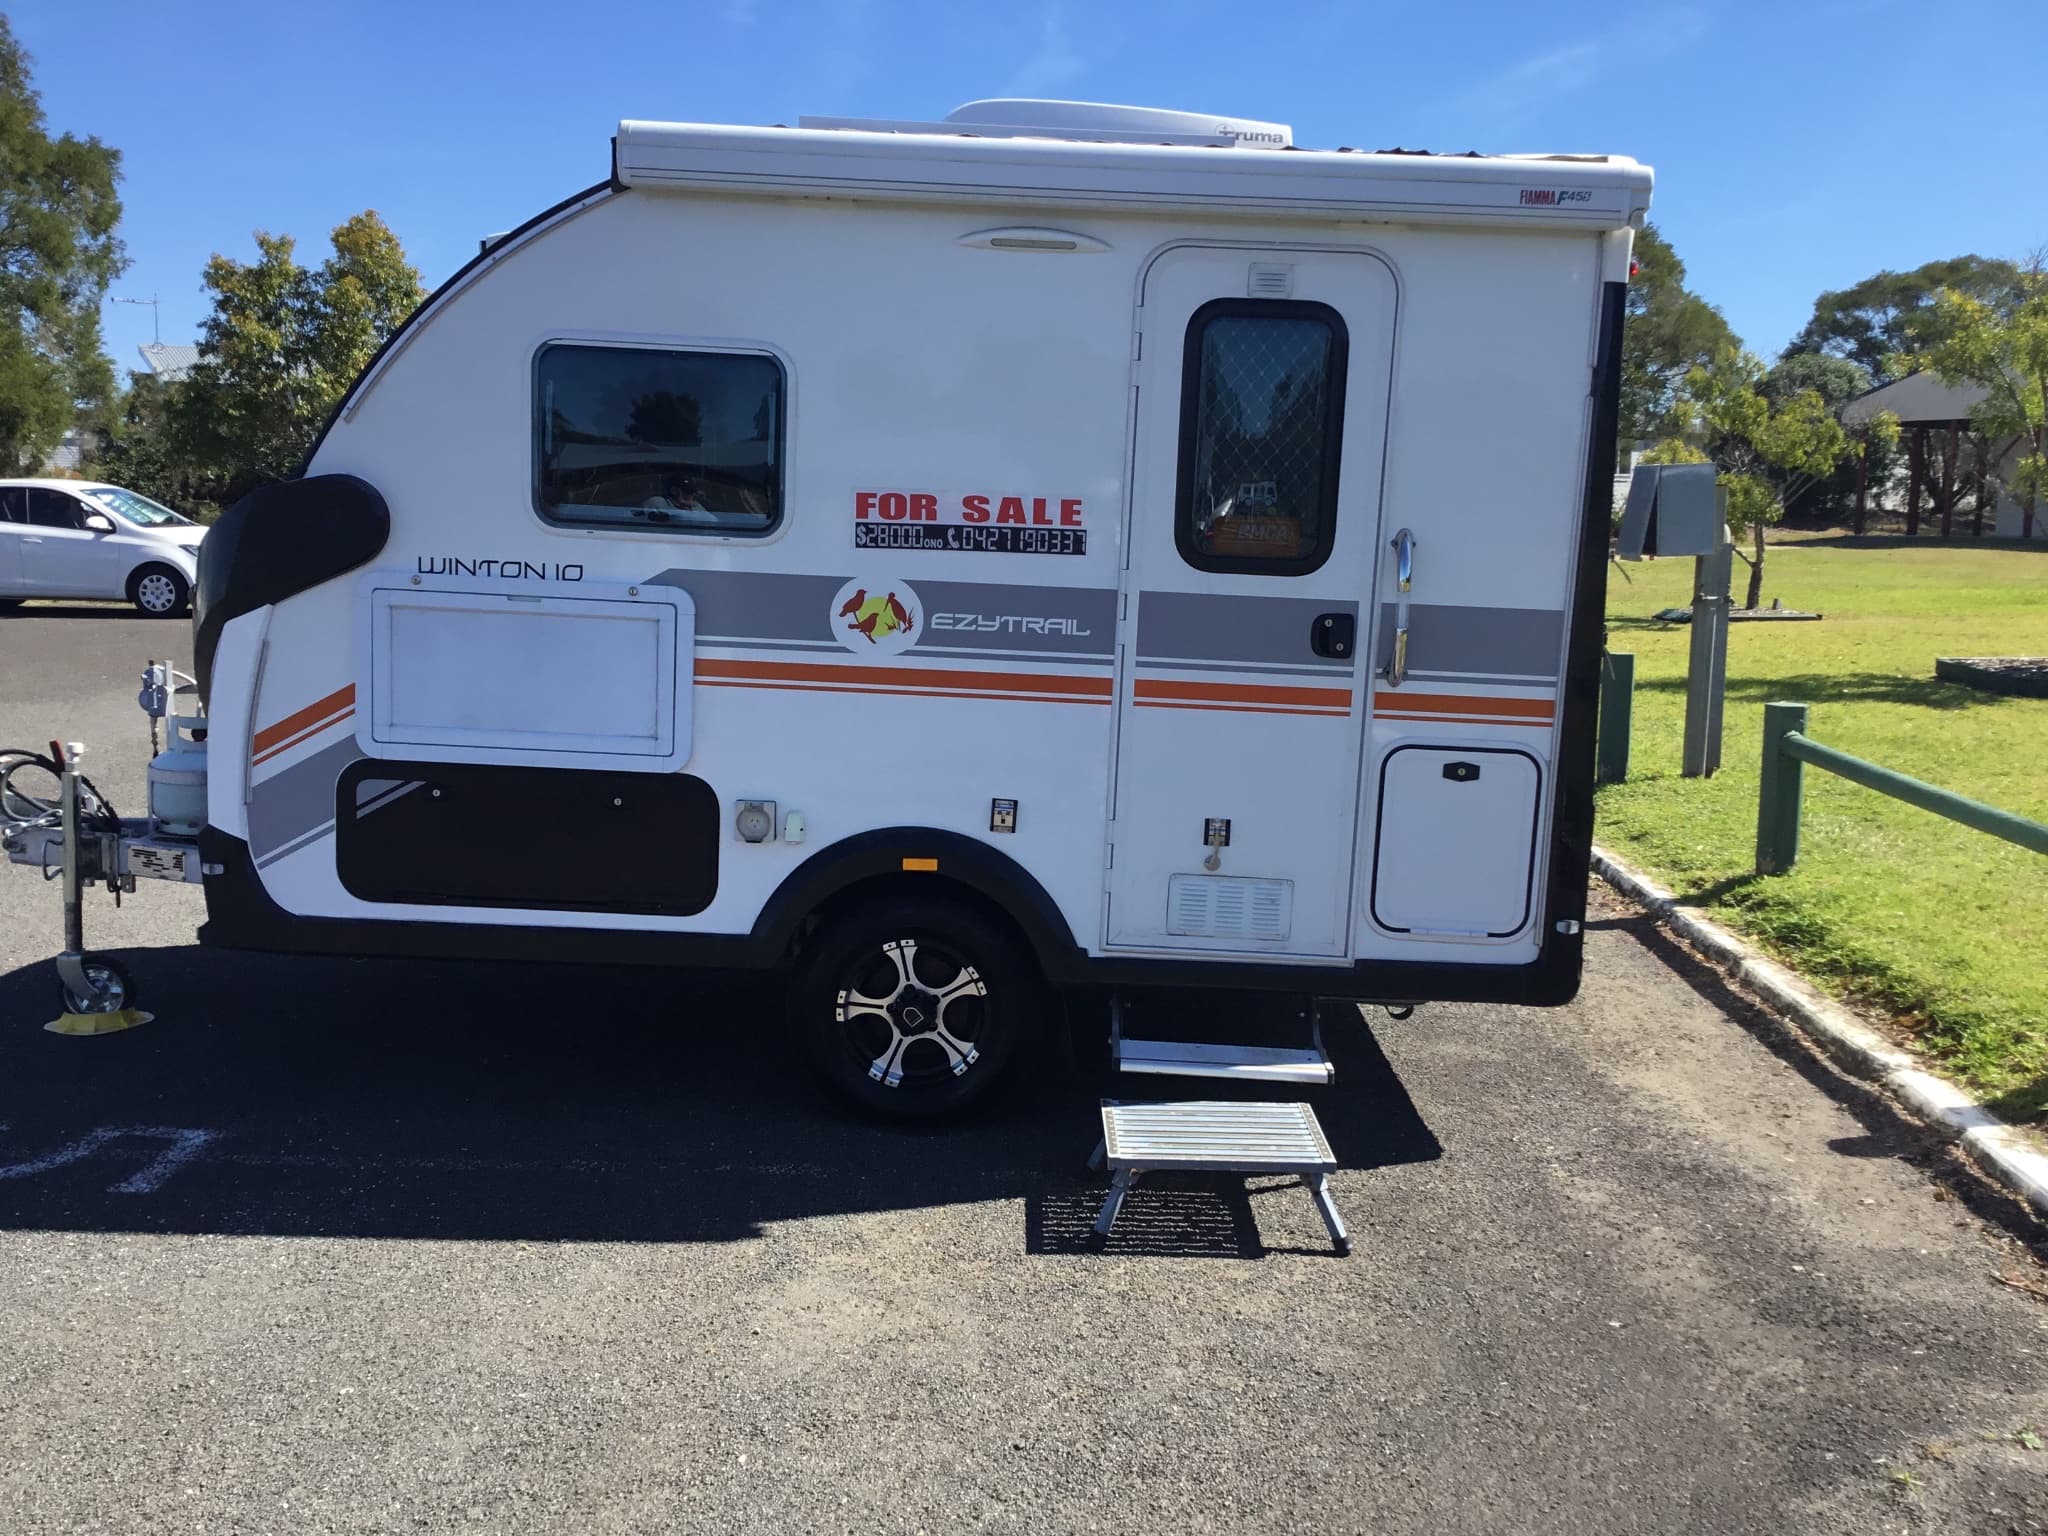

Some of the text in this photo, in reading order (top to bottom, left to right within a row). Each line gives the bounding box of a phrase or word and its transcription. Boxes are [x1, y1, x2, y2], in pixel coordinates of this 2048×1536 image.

[1520, 189, 1557, 206] FIAMMA
[855, 492, 1083, 526] FOR SALE
[418, 556, 546, 580] WINTON
[931, 612, 1092, 637] EZYTRAIL
